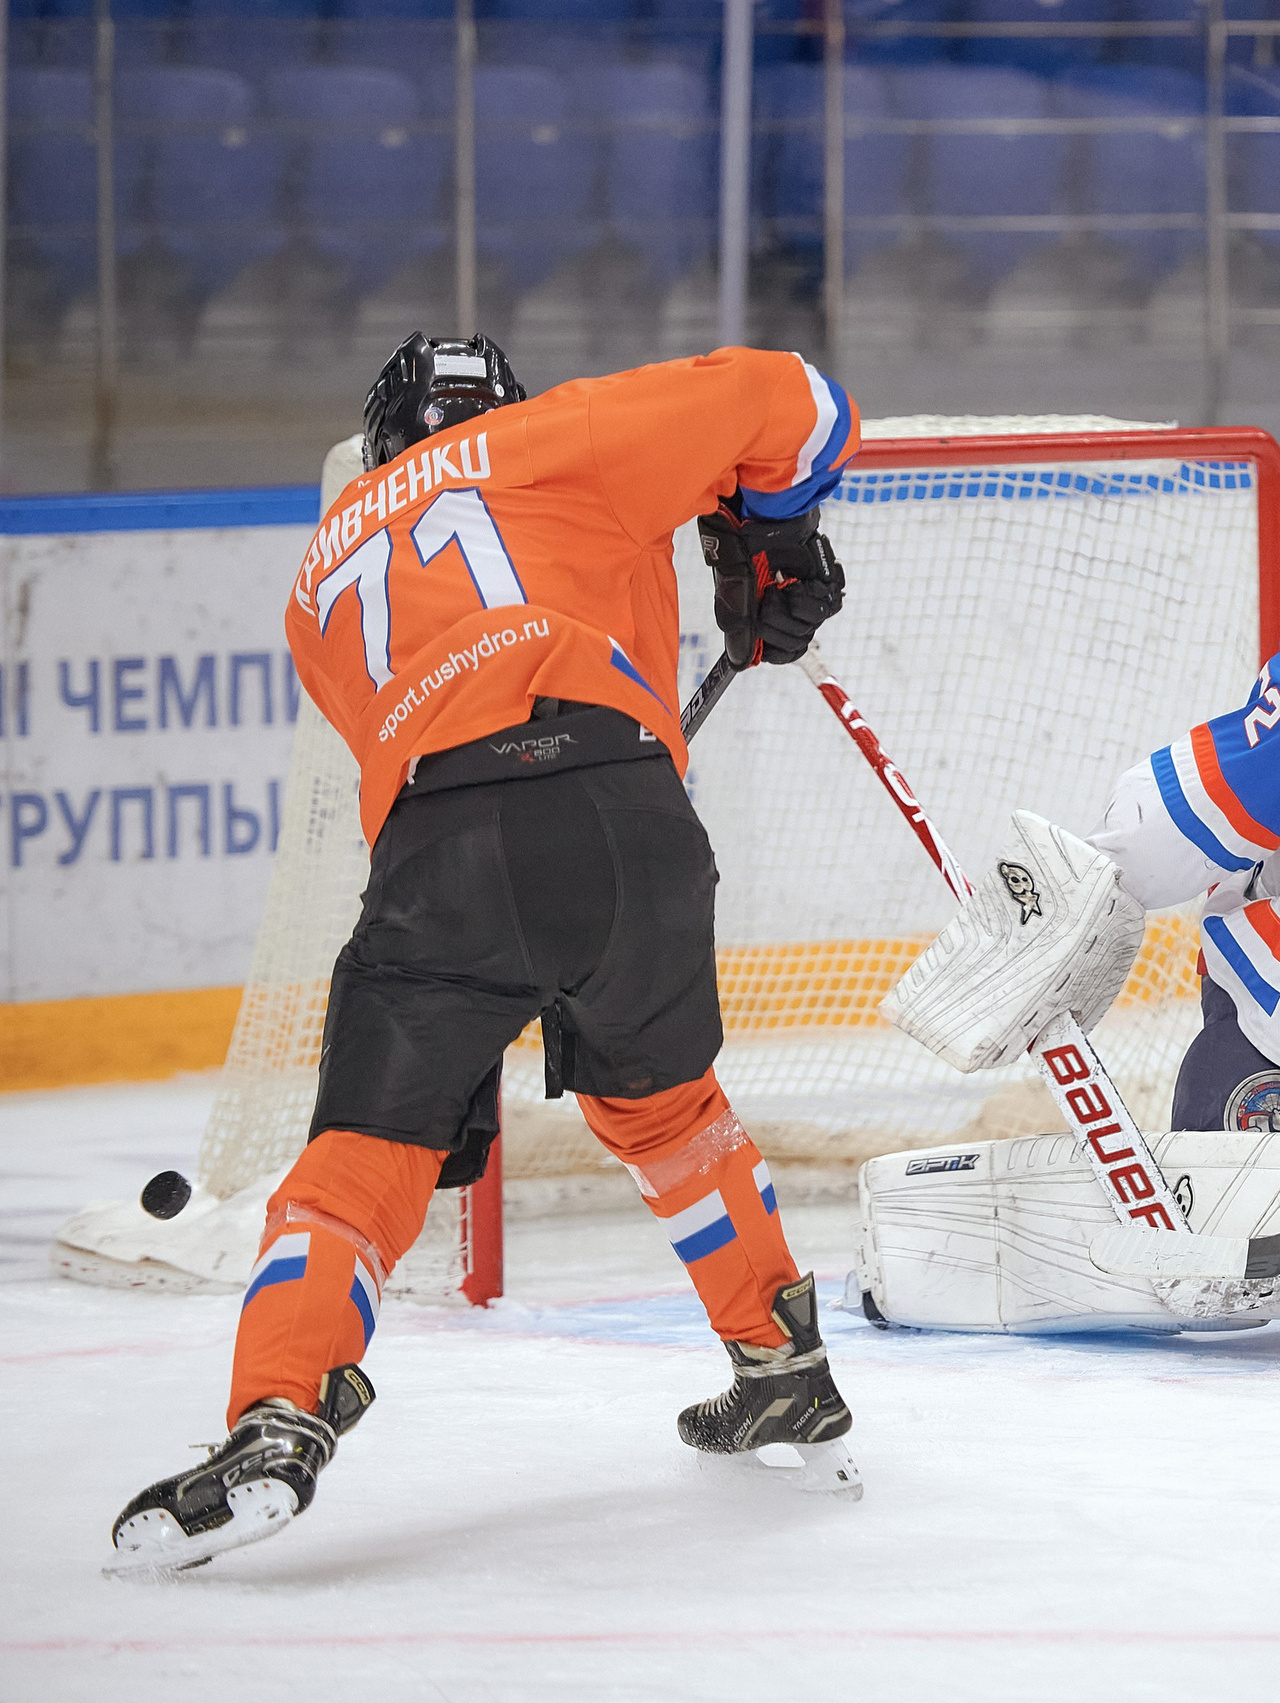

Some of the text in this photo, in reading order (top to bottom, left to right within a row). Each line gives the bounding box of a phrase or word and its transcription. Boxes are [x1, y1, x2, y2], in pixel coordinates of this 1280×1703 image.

[315, 486, 529, 693] 71
[378, 618, 550, 742] sport.rushydro.ru
[489, 733, 578, 754] VAPOR
[0, 781, 280, 868] РУППЫ
[1042, 1043, 1177, 1232] BAUER
[792, 1405, 816, 1432] TACKS
